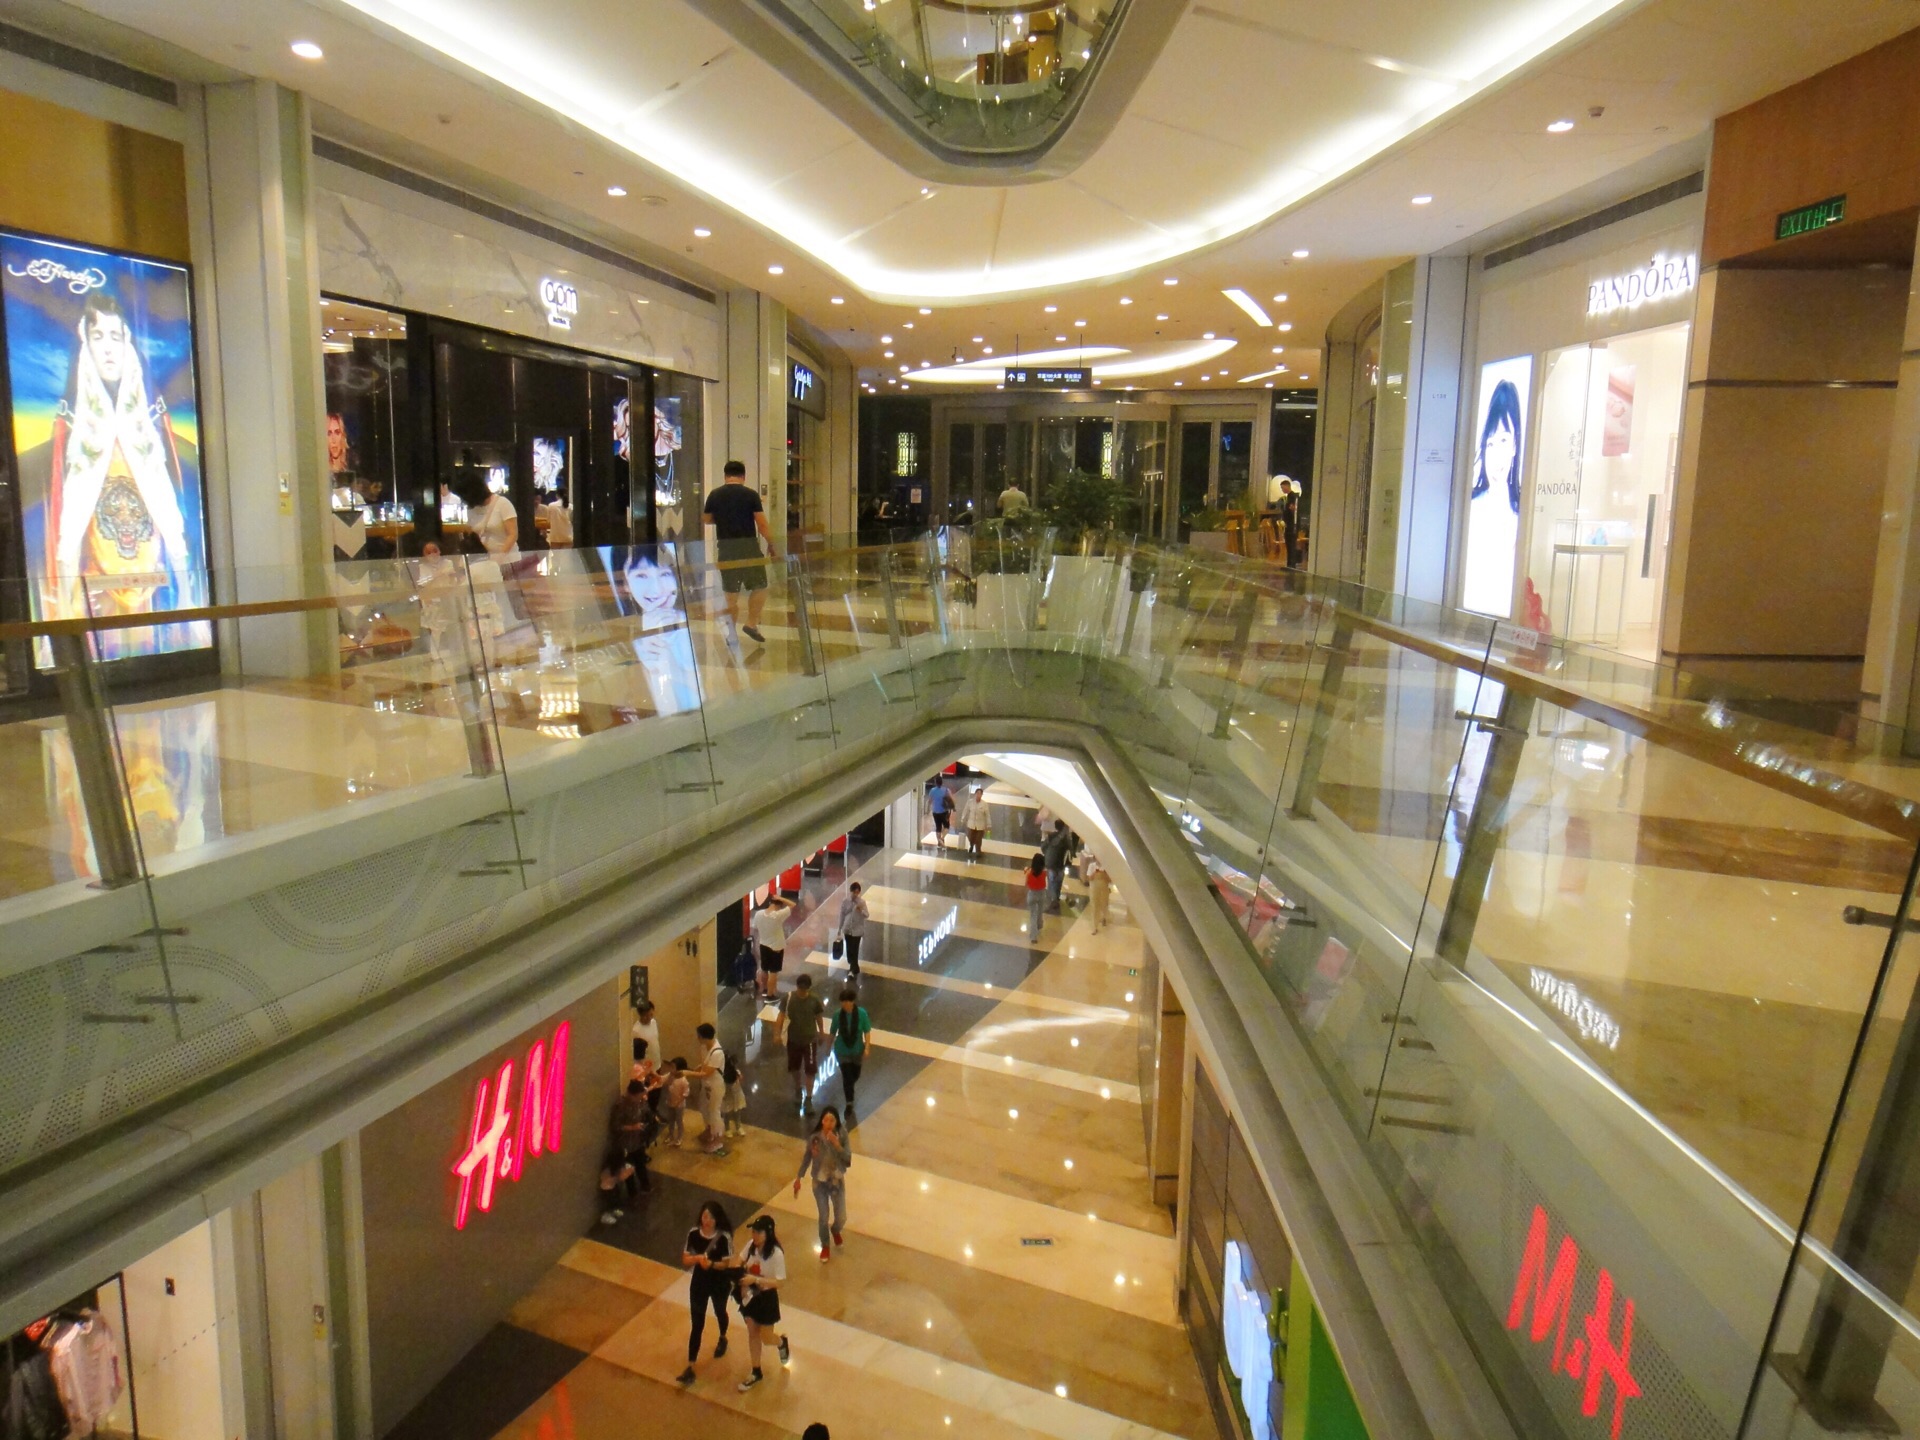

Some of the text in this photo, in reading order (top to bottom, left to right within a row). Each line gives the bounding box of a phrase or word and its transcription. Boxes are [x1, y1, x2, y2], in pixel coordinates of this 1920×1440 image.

[1586, 256, 1692, 313] PANDORA
[1537, 480, 1577, 495] PANDORA
[453, 1021, 570, 1230] H&M
